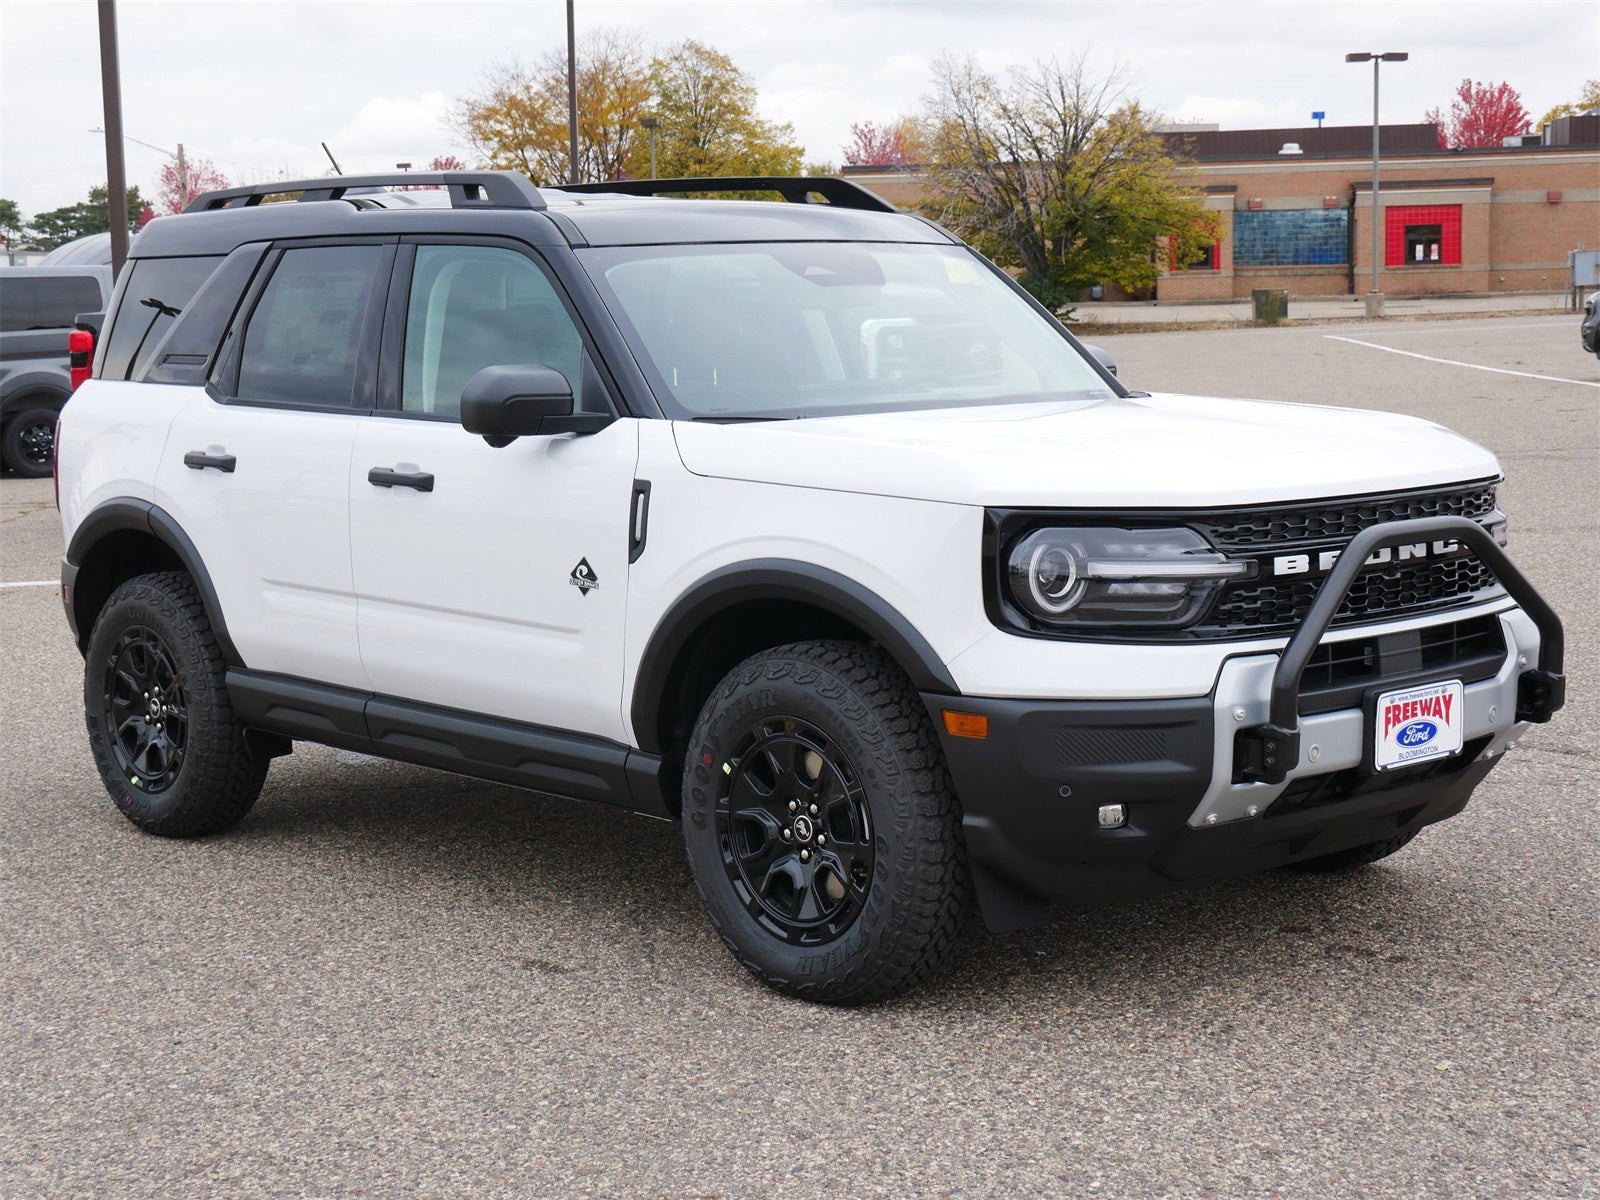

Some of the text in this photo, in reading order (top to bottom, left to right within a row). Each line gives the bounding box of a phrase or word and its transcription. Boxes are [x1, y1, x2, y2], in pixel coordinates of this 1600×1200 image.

[1273, 539, 1469, 576] BRONC
[1384, 693, 1454, 742] FREEWAY
[1403, 724, 1431, 744] Ford
[1398, 745, 1438, 760] BLOOMINGTON
